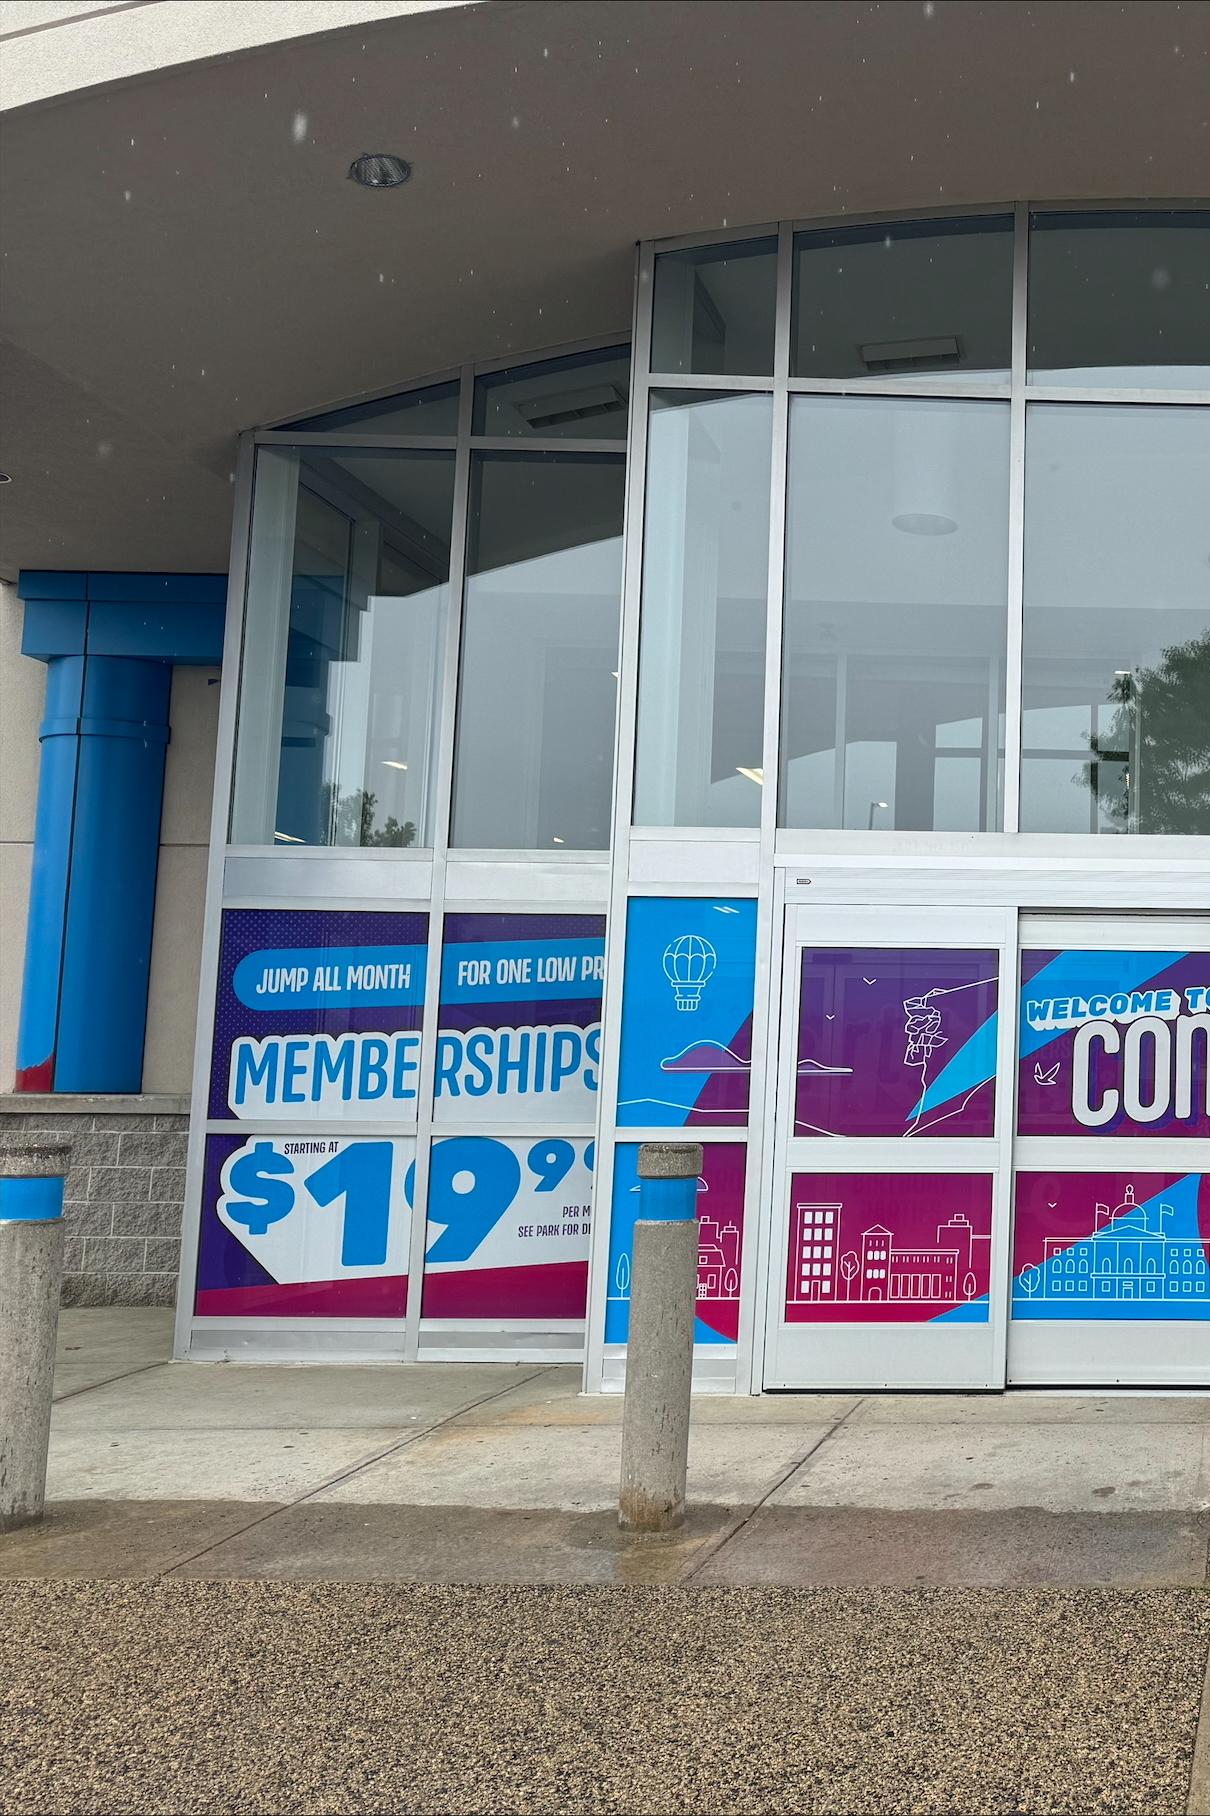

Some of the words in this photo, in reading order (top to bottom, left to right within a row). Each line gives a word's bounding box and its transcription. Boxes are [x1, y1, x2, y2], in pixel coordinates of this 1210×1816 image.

[256, 967, 309, 994] JUMP
[312, 966, 342, 992] ALL
[346, 963, 411, 990] MONTH
[457, 960, 491, 986] FOR
[496, 958, 532, 984] ONE
[536, 956, 577, 983] LOW
[1028, 990, 1173, 1022] WELCOME
[284, 1141, 326, 1155] STARTING
[328, 1141, 339, 1153] AT
[562, 1205, 580, 1218] PER
[518, 1225, 534, 1238] SEE
[536, 1224, 560, 1237] PARK
[562, 1223, 579, 1236] FOR
